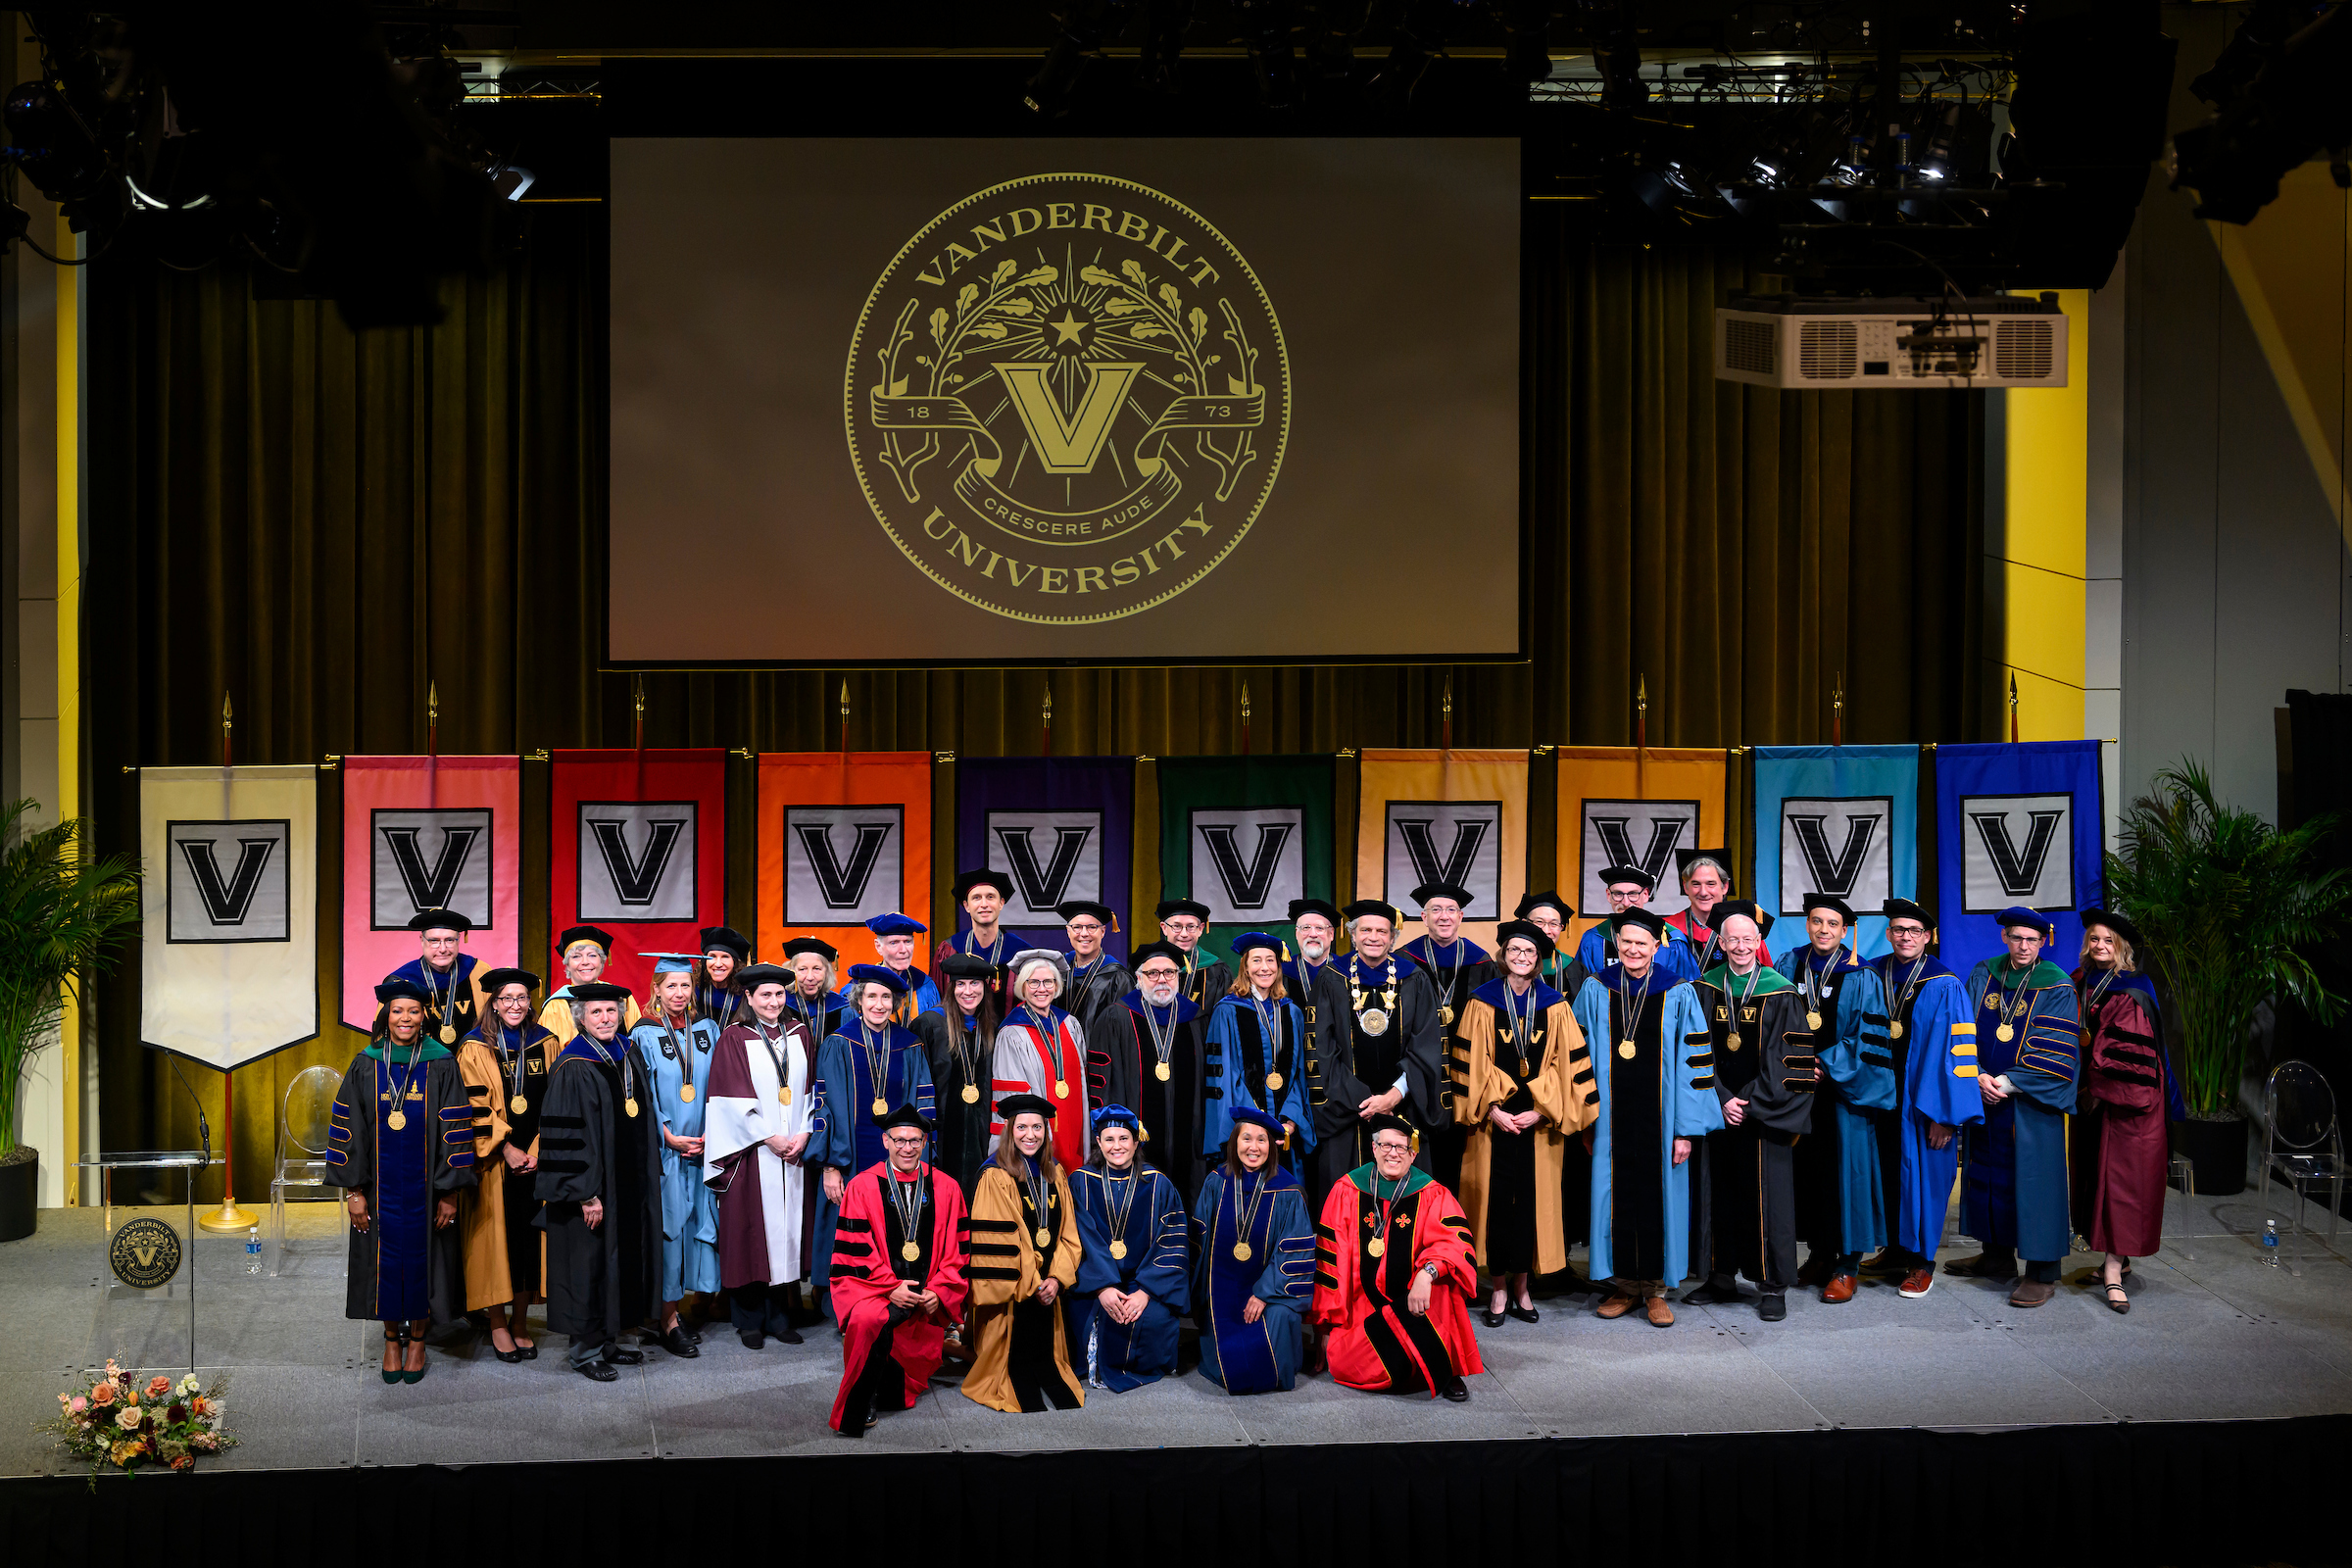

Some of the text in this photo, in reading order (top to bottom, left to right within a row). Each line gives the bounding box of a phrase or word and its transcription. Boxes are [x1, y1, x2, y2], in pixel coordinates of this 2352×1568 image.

[915, 202, 1221, 289] VANDERBILT
[906, 406, 930, 419] 18
[990, 362, 1147, 474] V
[1204, 405, 1232, 418] 73
[922, 502, 1214, 595] UNIVERSITY
[984, 495, 1154, 536] CRESCERE AUDE
[175, 838, 280, 926] V
[379, 826, 482, 911] V
[586, 818, 688, 906] V
[791, 822, 895, 909] V
[993, 825, 1095, 912] V
[1197, 822, 1297, 909] V
[1393, 818, 1494, 889] V
[1589, 816, 1690, 903] V
[1786, 813, 1883, 899] V
[1969, 809, 2065, 897] V
[455, 1000, 470, 1014] V
[1498, 1028, 1544, 1044] V V
[1743, 1008, 1755, 1020] V
[527, 1061, 541, 1073] V
[120, 1221, 171, 1238] VANDERBILT
[132, 1247, 159, 1267] V
[122, 1268, 171, 1286] UNIVERSITY
